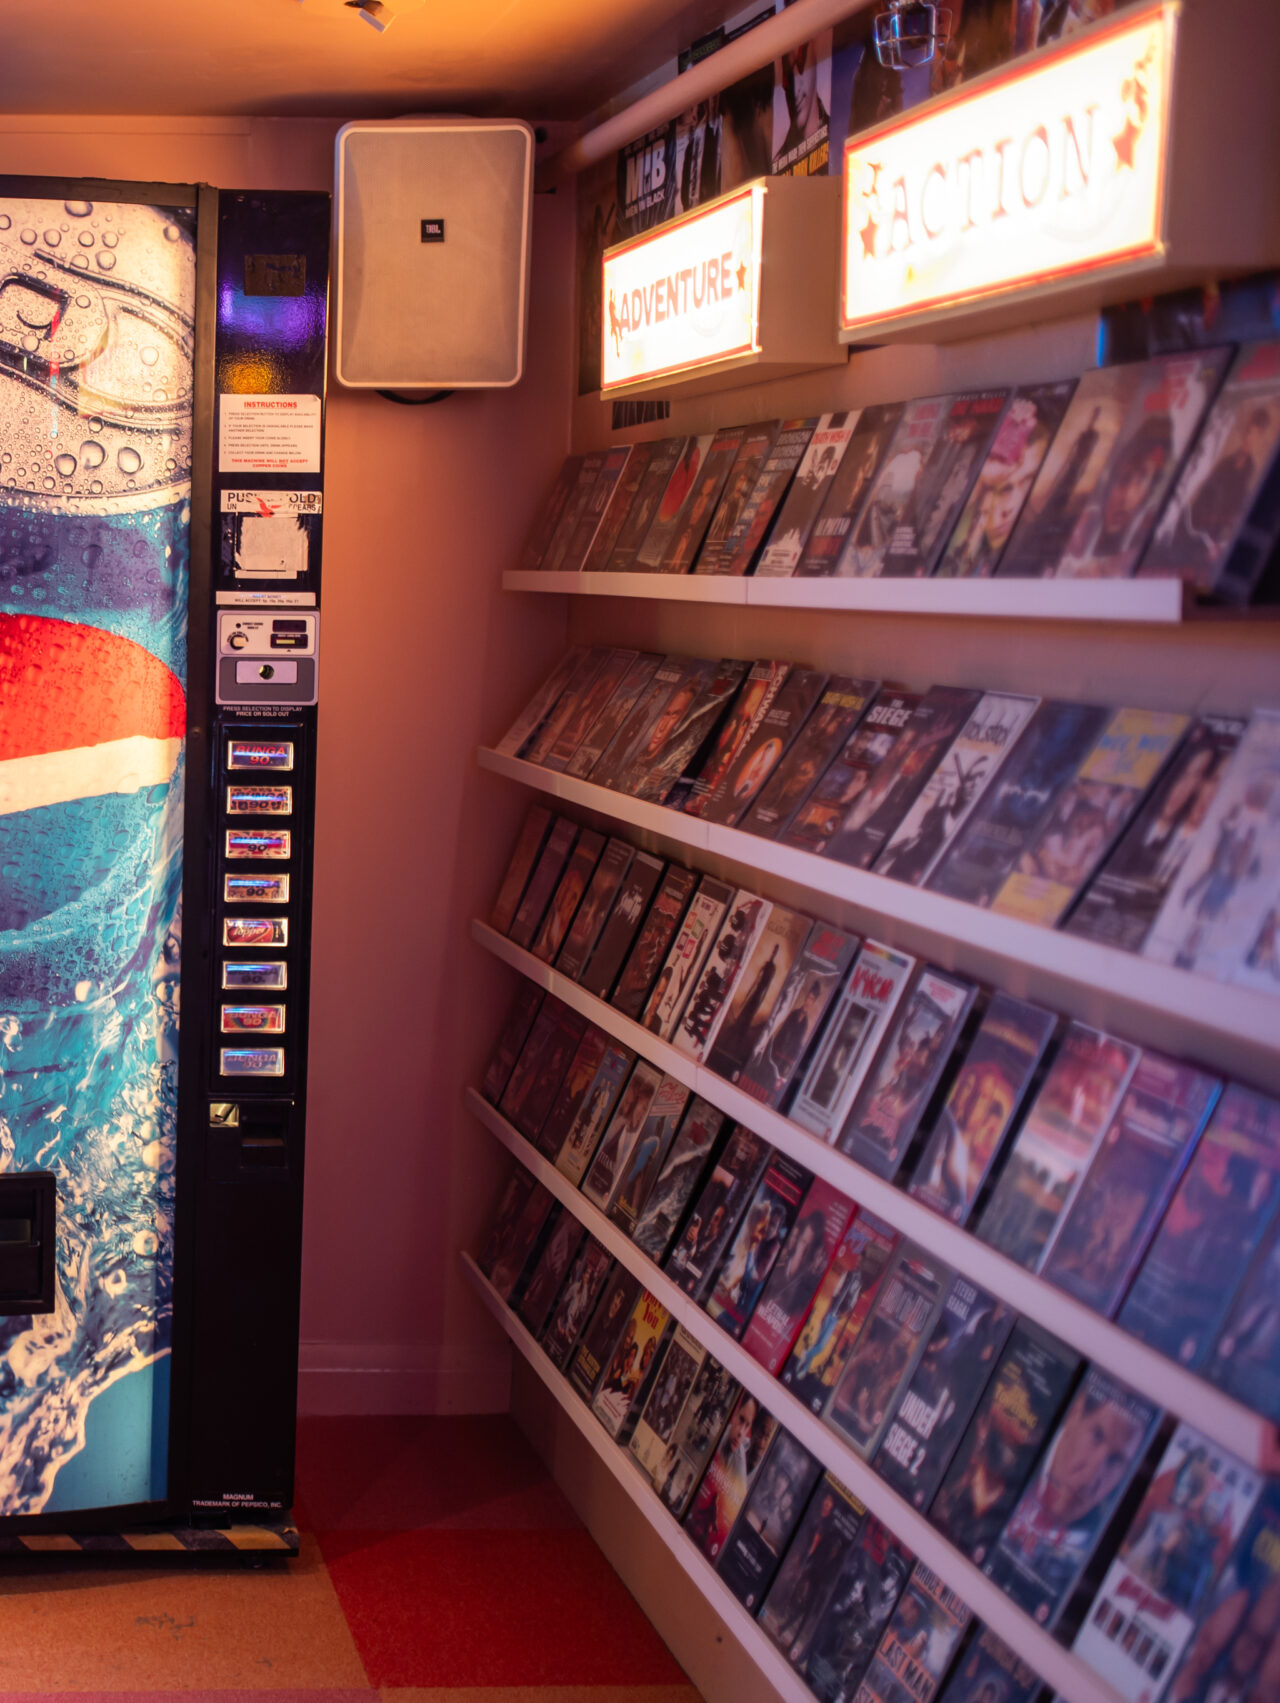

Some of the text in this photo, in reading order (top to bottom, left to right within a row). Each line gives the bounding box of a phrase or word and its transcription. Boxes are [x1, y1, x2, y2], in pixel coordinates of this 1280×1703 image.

[886, 103, 1100, 257] ACTION
[425, 223, 441, 234] JBL
[620, 251, 733, 334] ADVENTURE
[866, 705, 913, 728] SIEGE
[890, 699, 904, 709] THE
[898, 1389, 937, 1440] UNDER
[883, 1421, 927, 1476] SIEGE 2
[880, 1631, 935, 1700] LAST MAN
